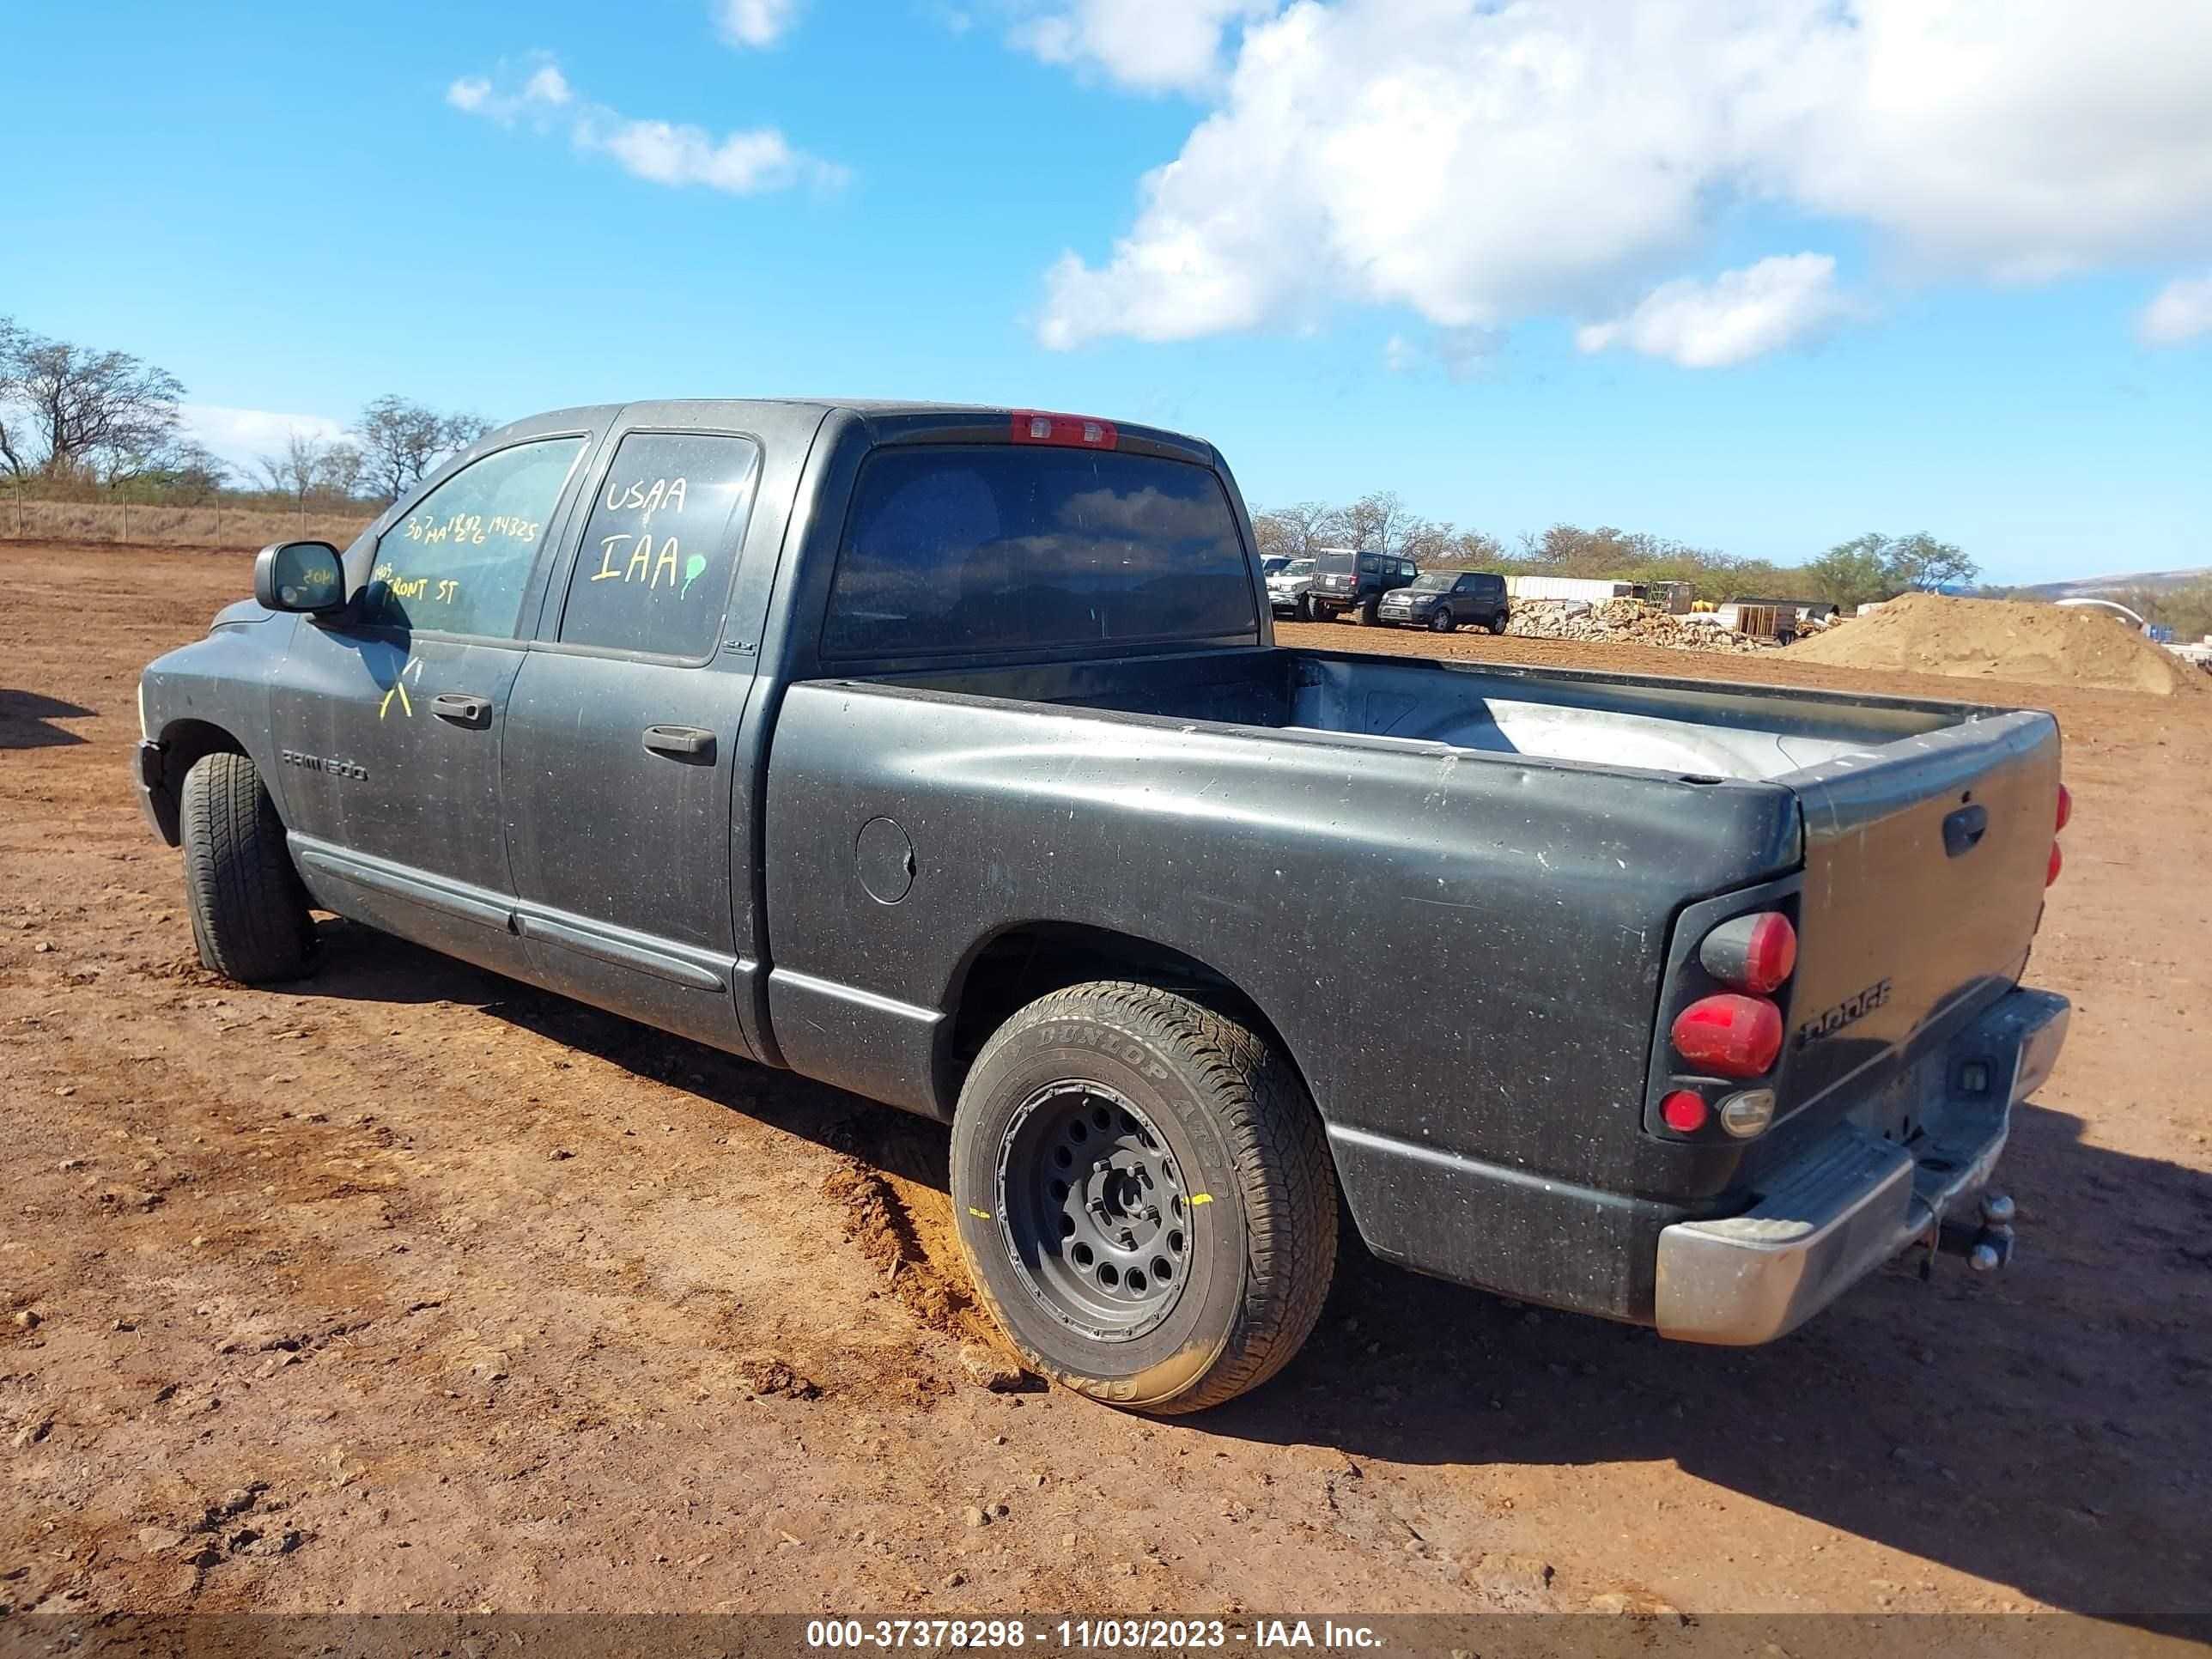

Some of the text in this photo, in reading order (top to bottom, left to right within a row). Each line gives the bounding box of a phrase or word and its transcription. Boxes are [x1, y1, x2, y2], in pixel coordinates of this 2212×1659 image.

[606, 477, 687, 514] USAA
[591, 533, 679, 590] IAA
[434, 579, 459, 605] ST
[1037, 1023, 1169, 1080] DUNLOP
